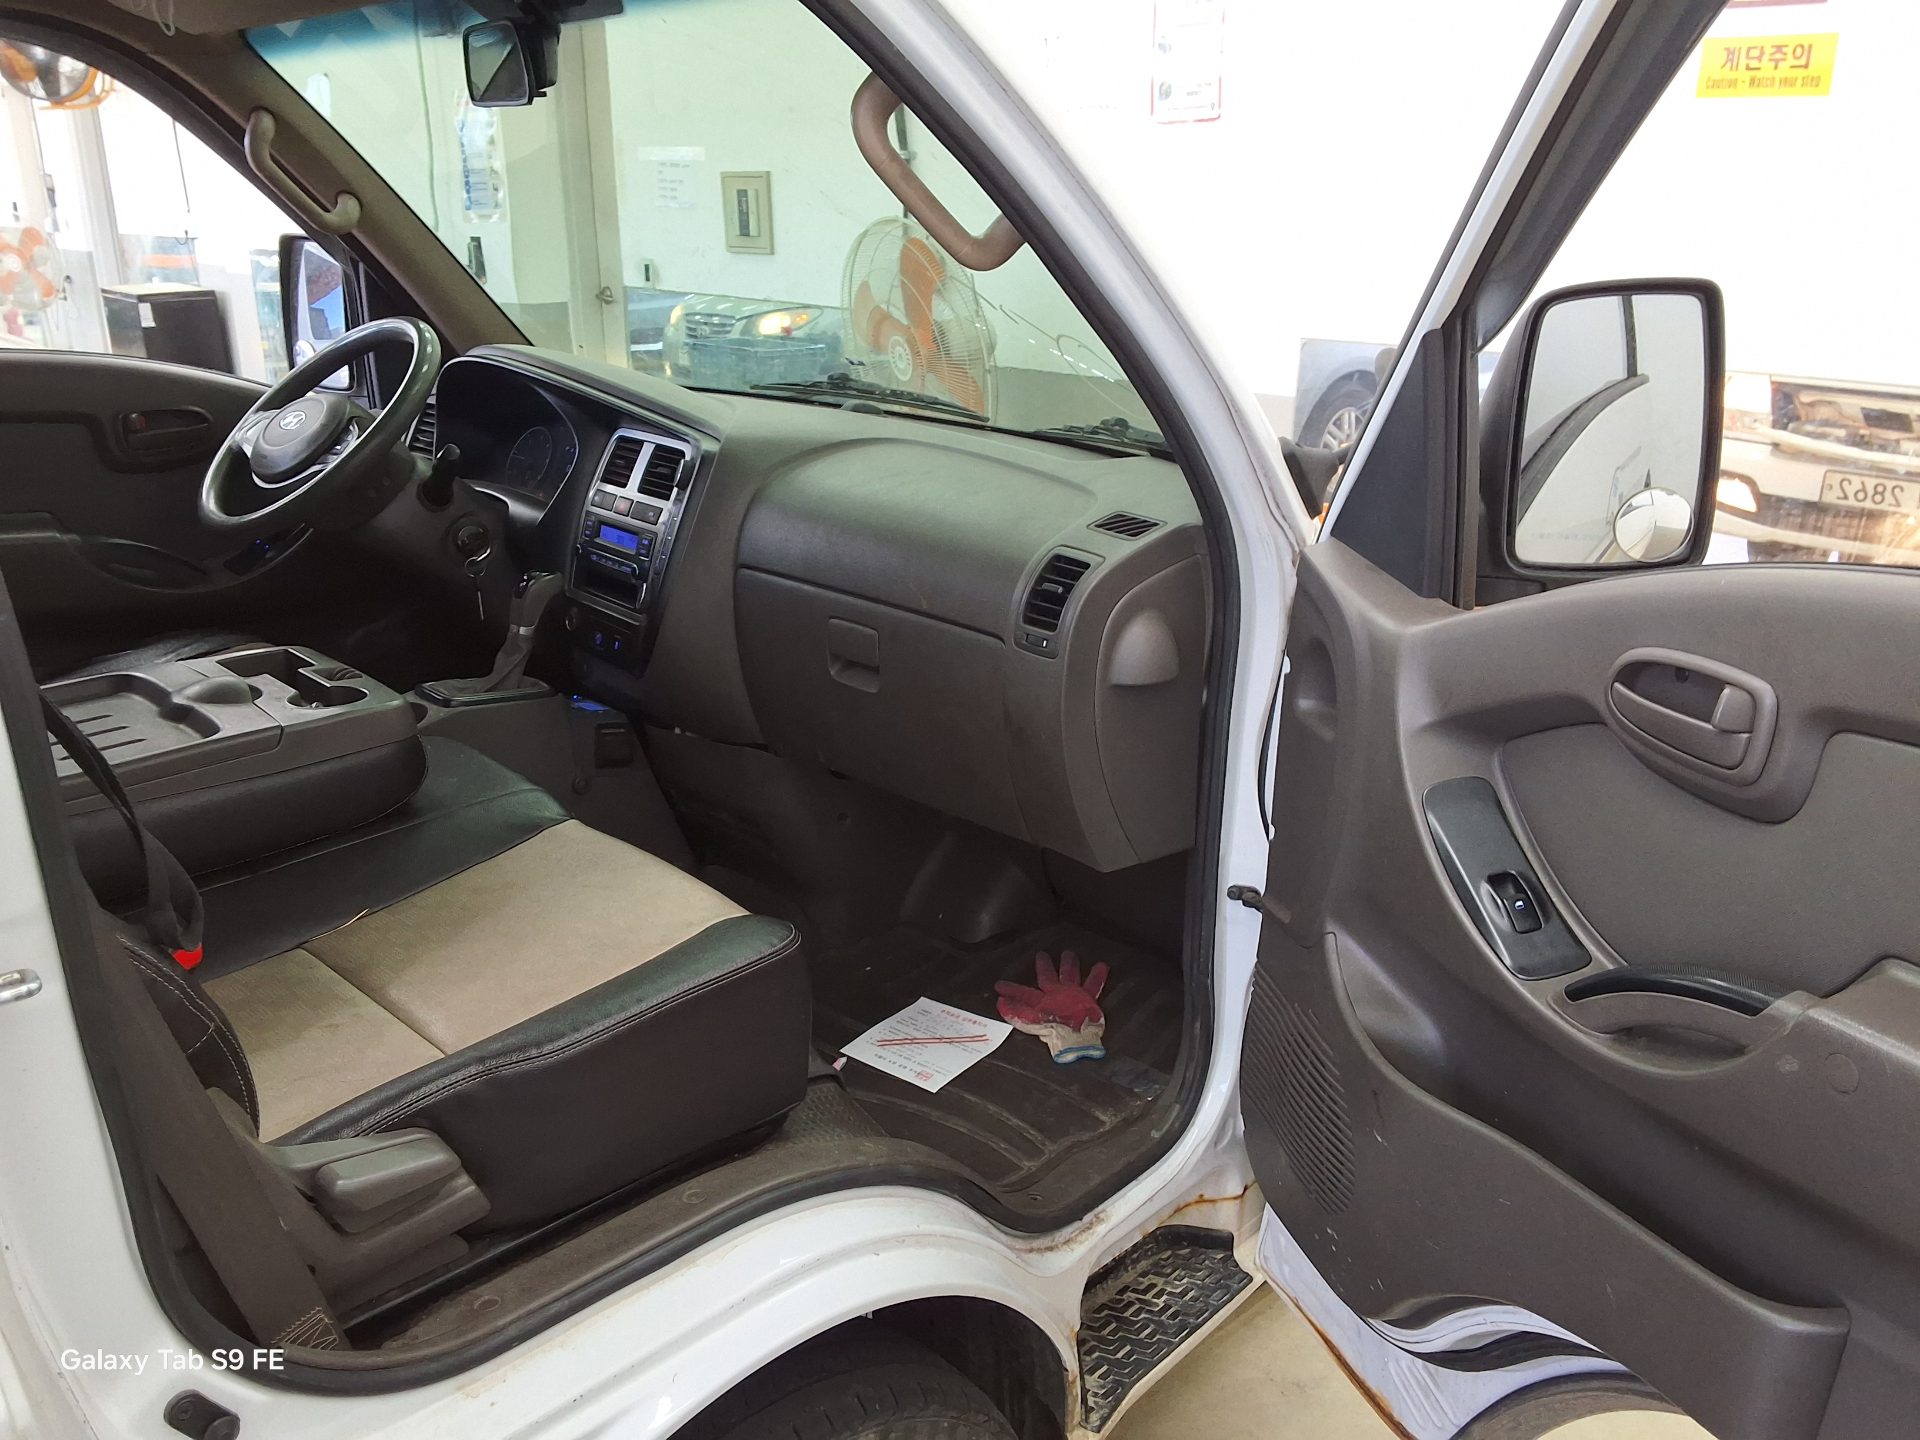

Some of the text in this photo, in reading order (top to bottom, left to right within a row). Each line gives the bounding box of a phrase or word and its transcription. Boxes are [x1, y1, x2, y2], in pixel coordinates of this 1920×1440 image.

[1721, 43, 1813, 72] 계단주의
[1705, 76, 1738, 90] Caution
[1748, 75, 1775, 88] Watch
[1778, 75, 1798, 89] your
[1801, 74, 1821, 88] step
